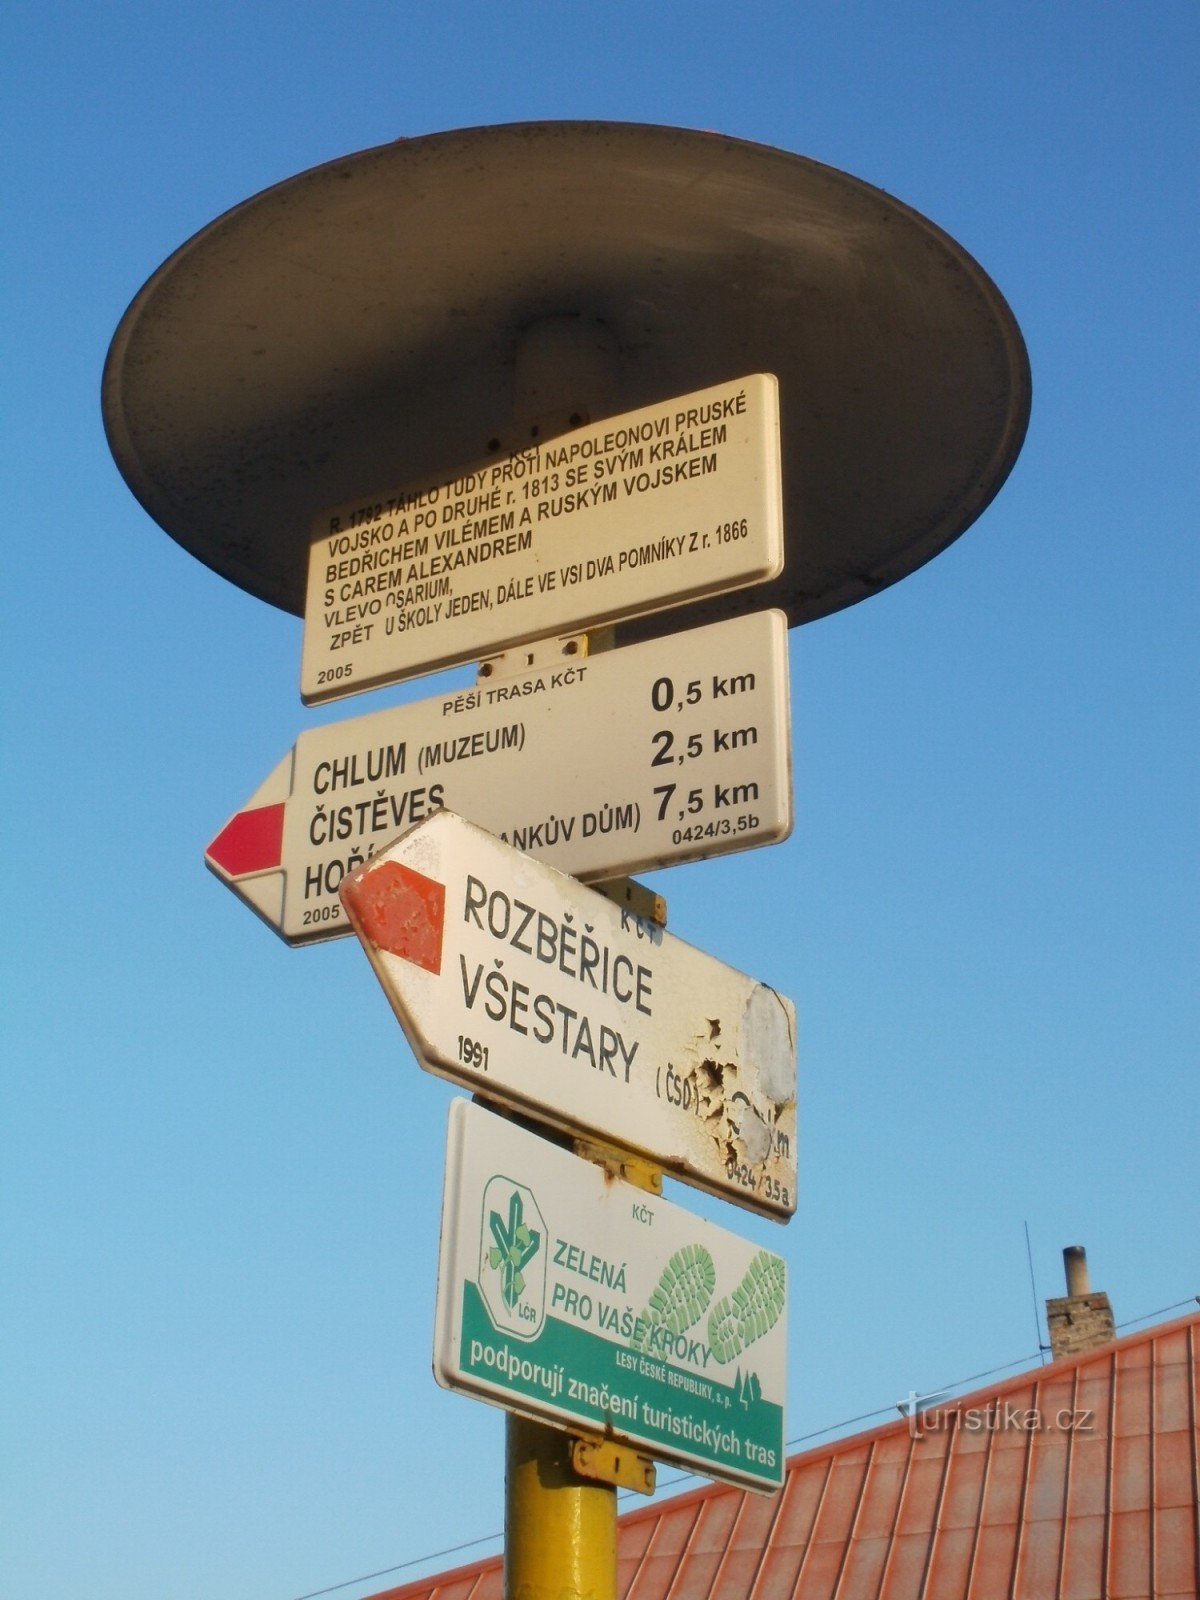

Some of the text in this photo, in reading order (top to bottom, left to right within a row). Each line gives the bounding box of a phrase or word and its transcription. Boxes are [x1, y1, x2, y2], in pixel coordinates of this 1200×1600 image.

[328, 424, 727, 558] VOJSKO A PO DRUHÉ r. 1813 SE SVÝM KRÁLEM
[350, 504, 382, 528] 1792
[387, 487, 440, 517] TÁHLO
[445, 470, 487, 500] TUDY
[491, 454, 541, 486] PROTI
[545, 416, 670, 471] NAPOLEONOVI
[675, 390, 747, 432] PRUSKÉ
[325, 452, 718, 583] BEDŘICHEM VILÉMEM A RUSKÝM VOJSKEM
[324, 529, 532, 608] S CAREM ALEXANDREM
[329, 518, 748, 651] ZPĚT U ŠKOLY JEDEN, DÁLE VE VSI DVA POMNÍKY Z r. 1866
[324, 598, 382, 628] VLEVO
[317, 663, 353, 685] 2005
[442, 667, 588, 716] PĚŠÍ TRASA KČT
[313, 672, 756, 795] CHLUM (MUZEUM) 0,5 km
[309, 725, 758, 846] ČISTĚVES 2,5 km
[582, 801, 641, 838] DŮM)
[653, 783, 704, 821] 7,5
[714, 781, 759, 809] km
[671, 814, 760, 845] 0424/3,5b
[303, 904, 340, 925] 2005
[464, 874, 653, 1017] ROZBĚŘICE
[457, 1035, 489, 1071] 1991
[459, 953, 639, 1084] VŠESTARY
[632, 1203, 655, 1226] KČT
[552, 1238, 628, 1294] ZELENÁ
[551, 1282, 712, 1368] PRO VAŠE KROKY
[470, 1339, 776, 1468] podporují značení turistických tras
[615, 1350, 637, 1372] LESY
[639, 1357, 666, 1382] ČESKÉ
